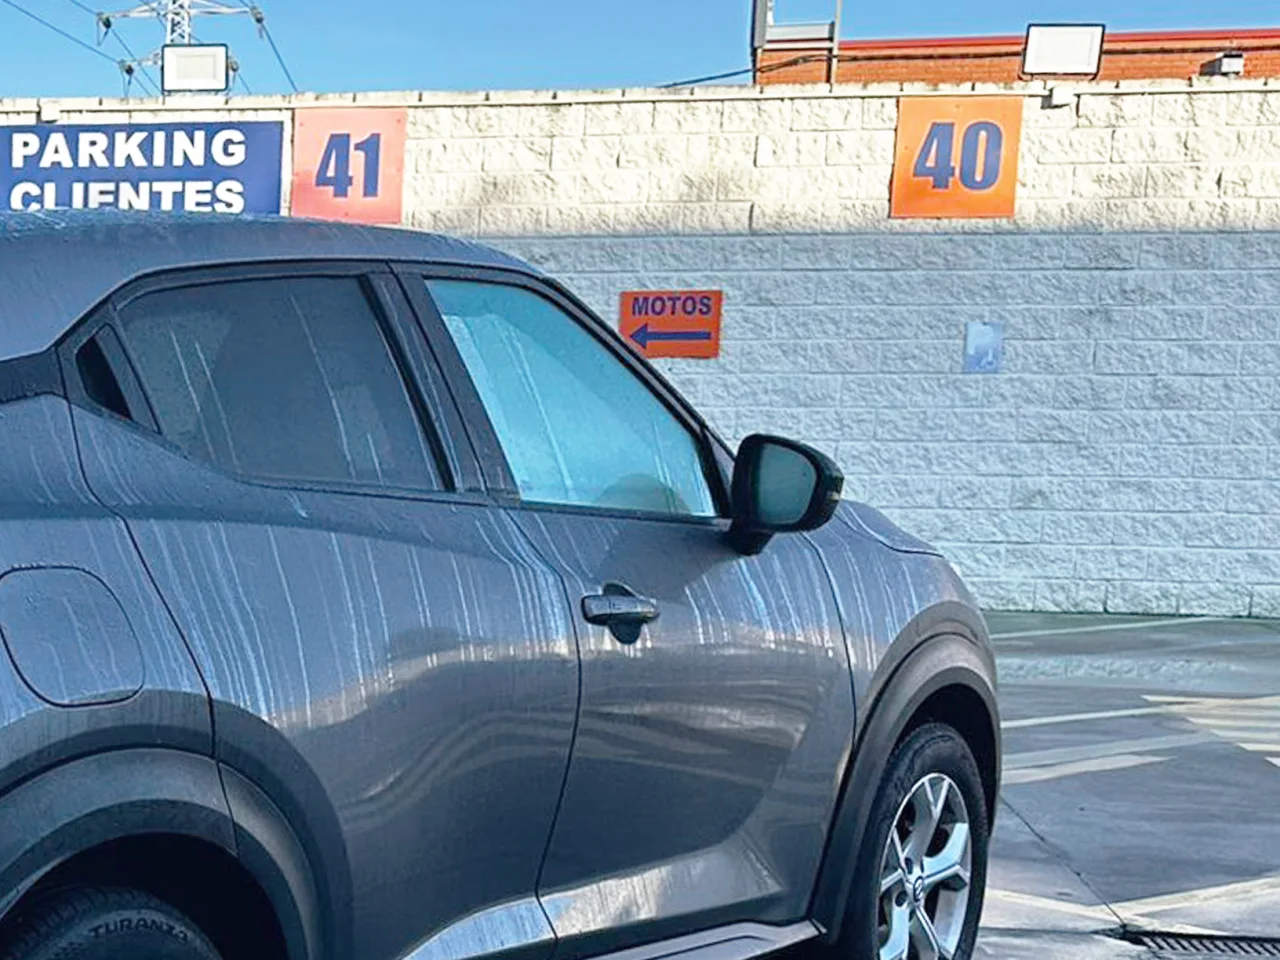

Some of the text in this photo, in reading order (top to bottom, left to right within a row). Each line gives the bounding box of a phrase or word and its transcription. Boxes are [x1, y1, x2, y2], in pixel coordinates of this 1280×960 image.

[11, 129, 246, 168] PARKING
[315, 132, 381, 198] 41
[912, 121, 1003, 191] 40
[11, 180, 244, 214] CLIENTES
[632, 296, 711, 316] MOTOS
